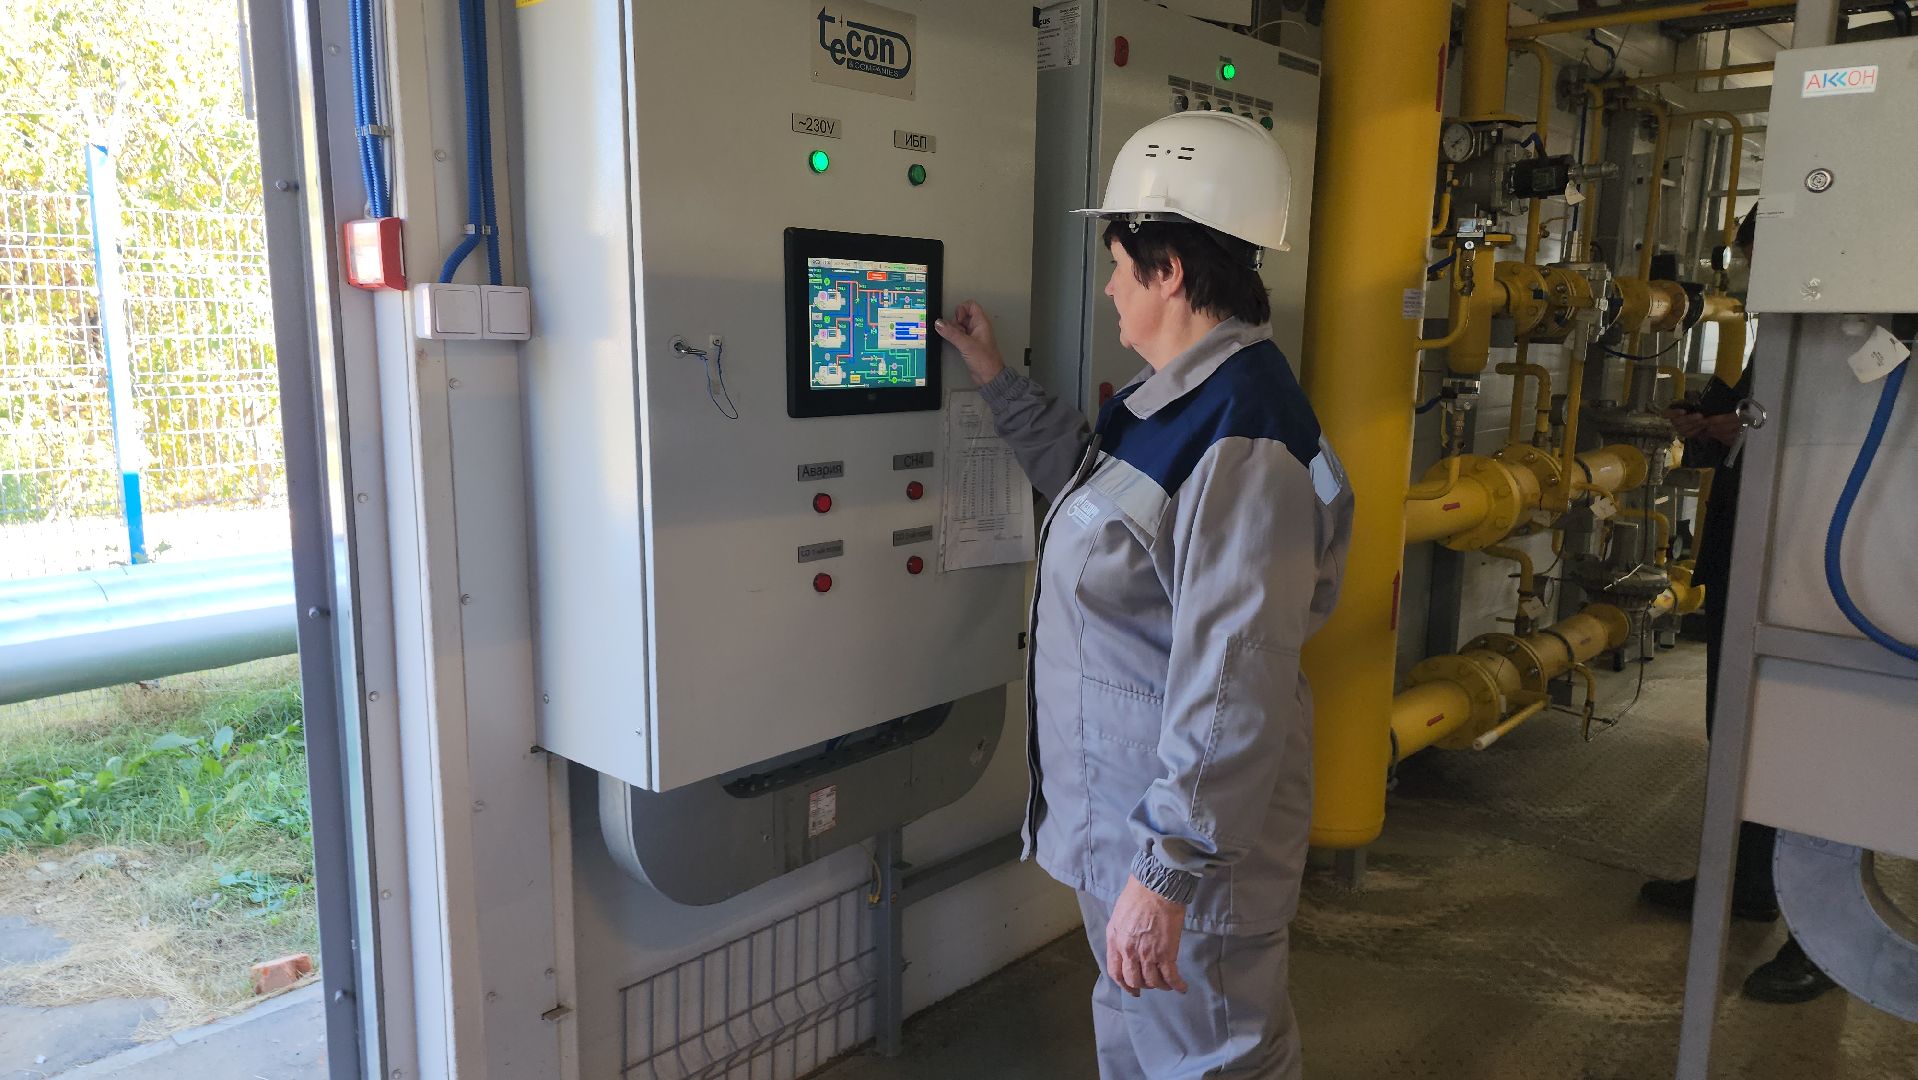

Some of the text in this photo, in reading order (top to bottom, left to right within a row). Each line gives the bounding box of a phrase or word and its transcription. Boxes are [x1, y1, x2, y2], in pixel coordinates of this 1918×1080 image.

[854, 61, 900, 78] COMPANIES
[905, 133, 927, 149] ИБП
[903, 454, 924, 467] CH4
[802, 464, 842, 479] Авария
